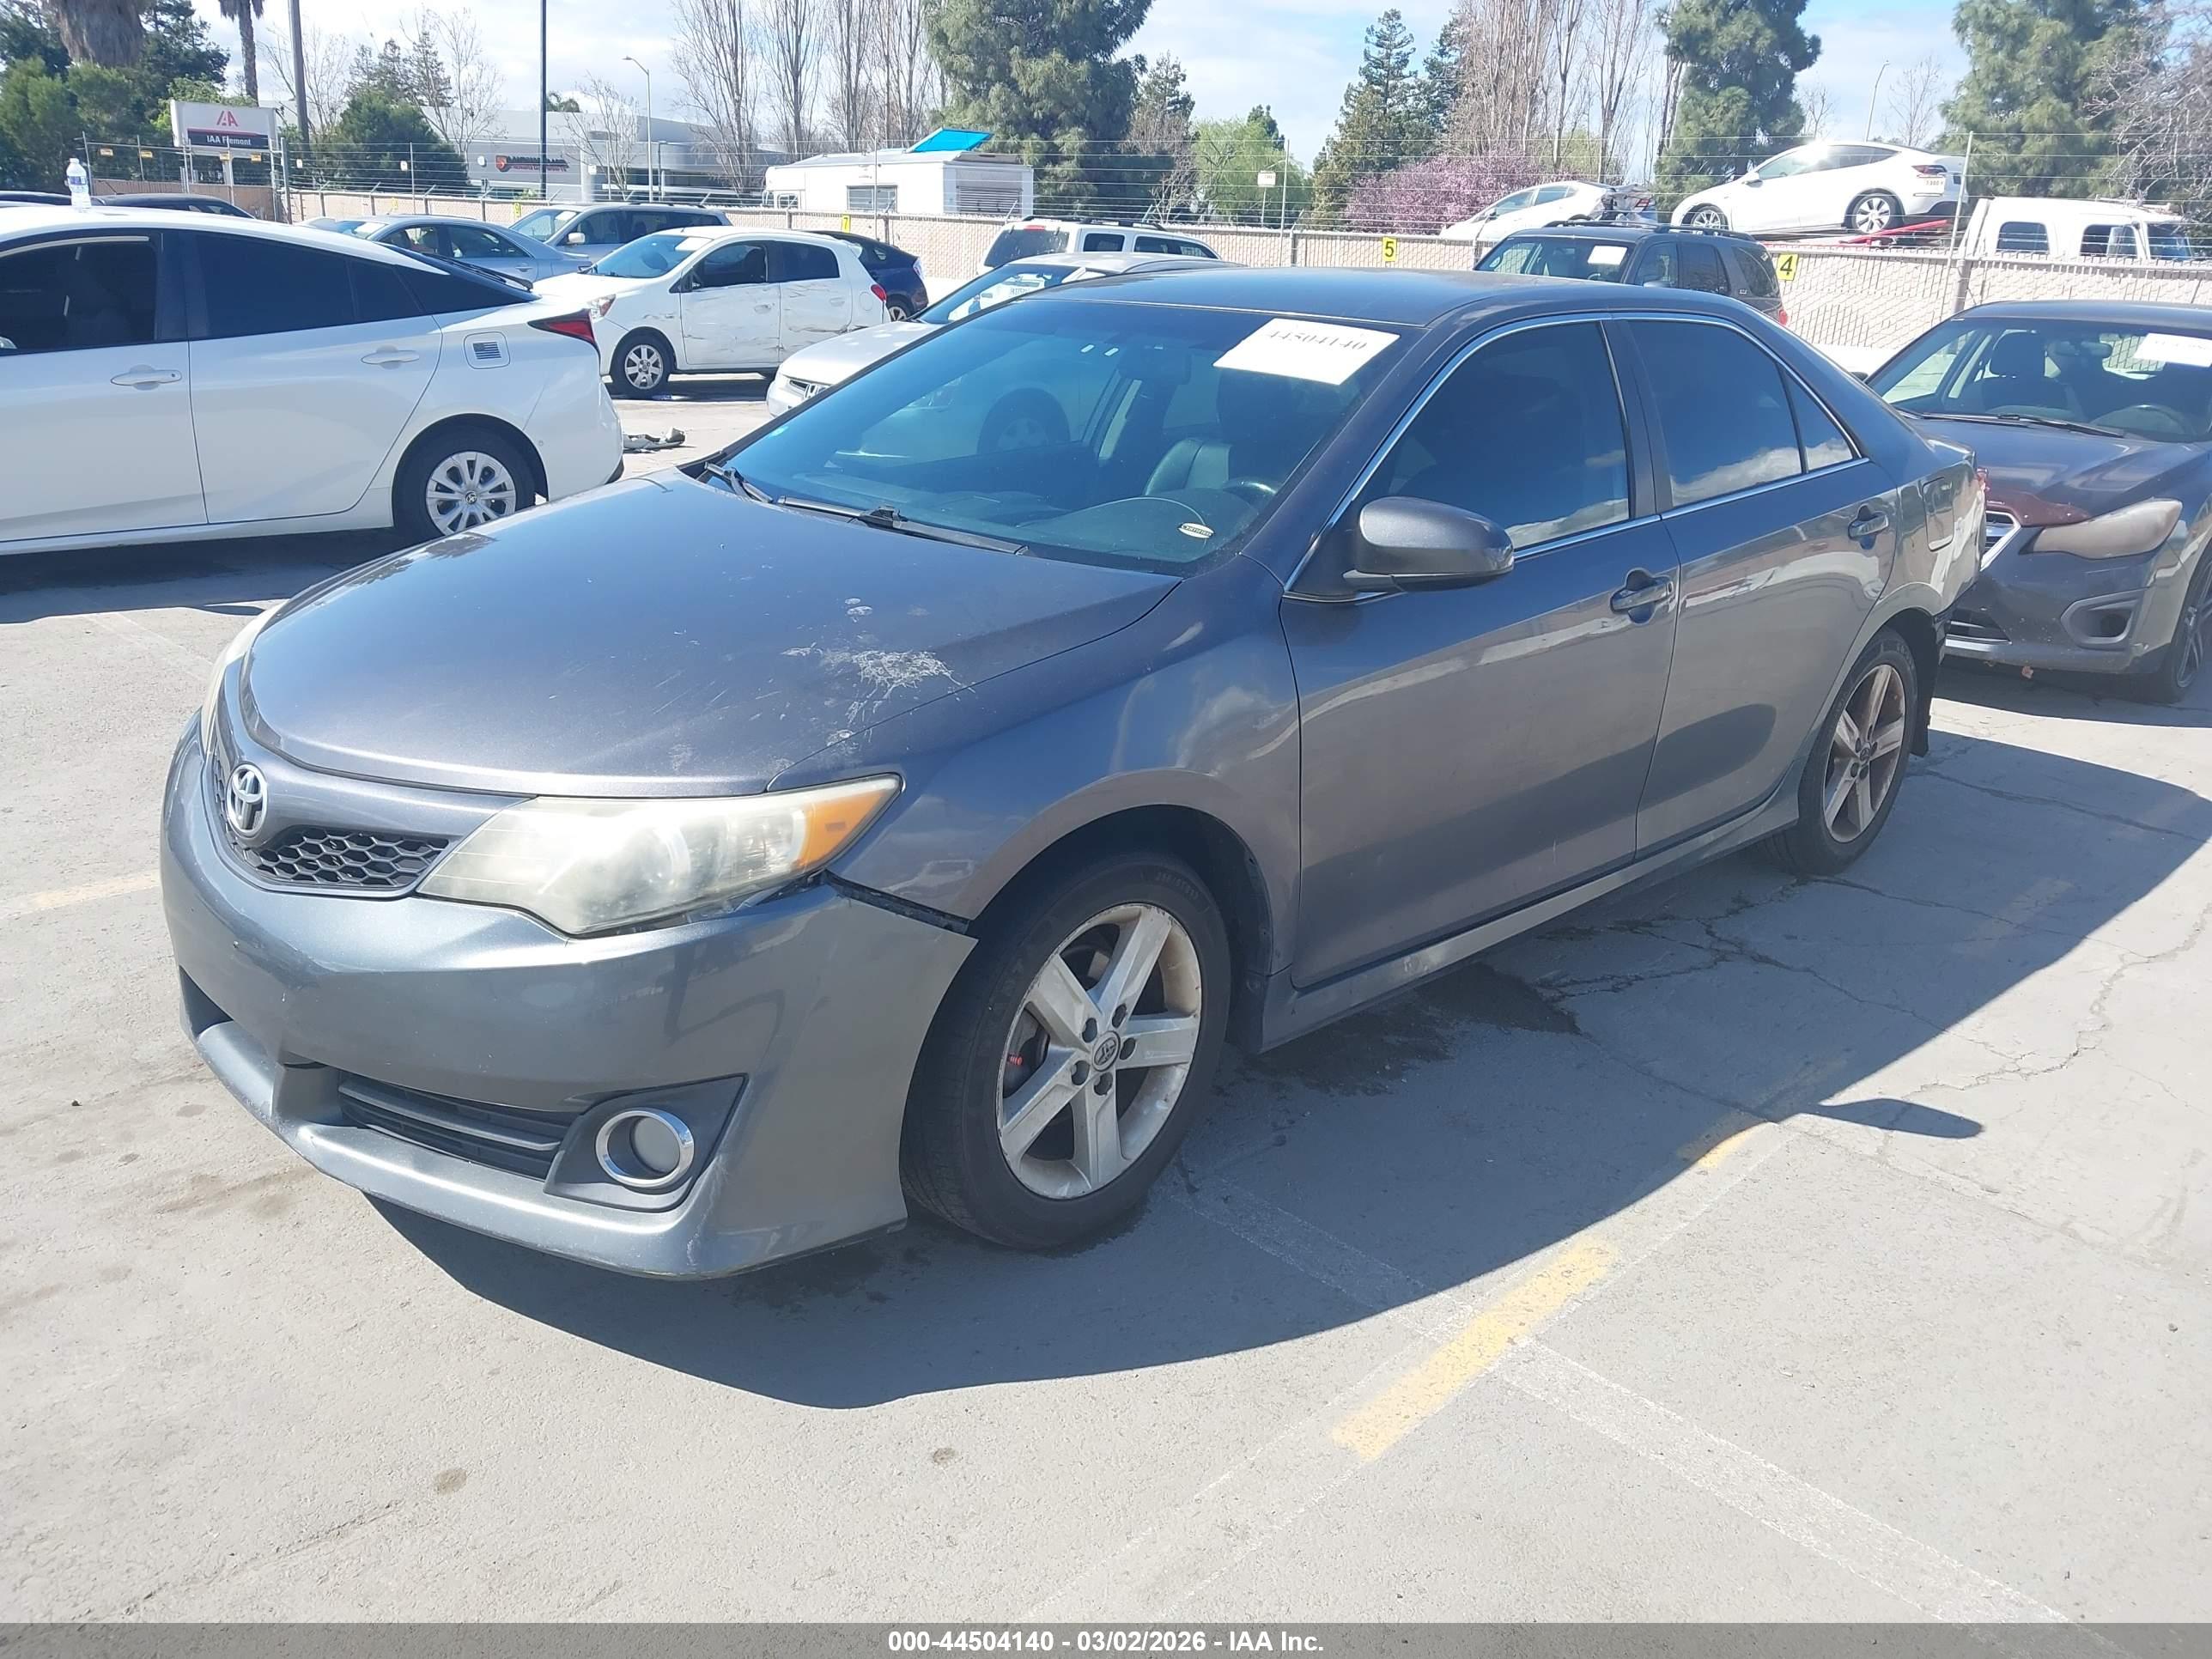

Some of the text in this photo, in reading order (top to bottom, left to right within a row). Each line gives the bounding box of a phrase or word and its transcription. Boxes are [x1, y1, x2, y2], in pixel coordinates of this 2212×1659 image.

[207, 135, 221, 143] IAA
[1385, 240, 1394, 258] 5
[1779, 255, 1793, 275] 4
